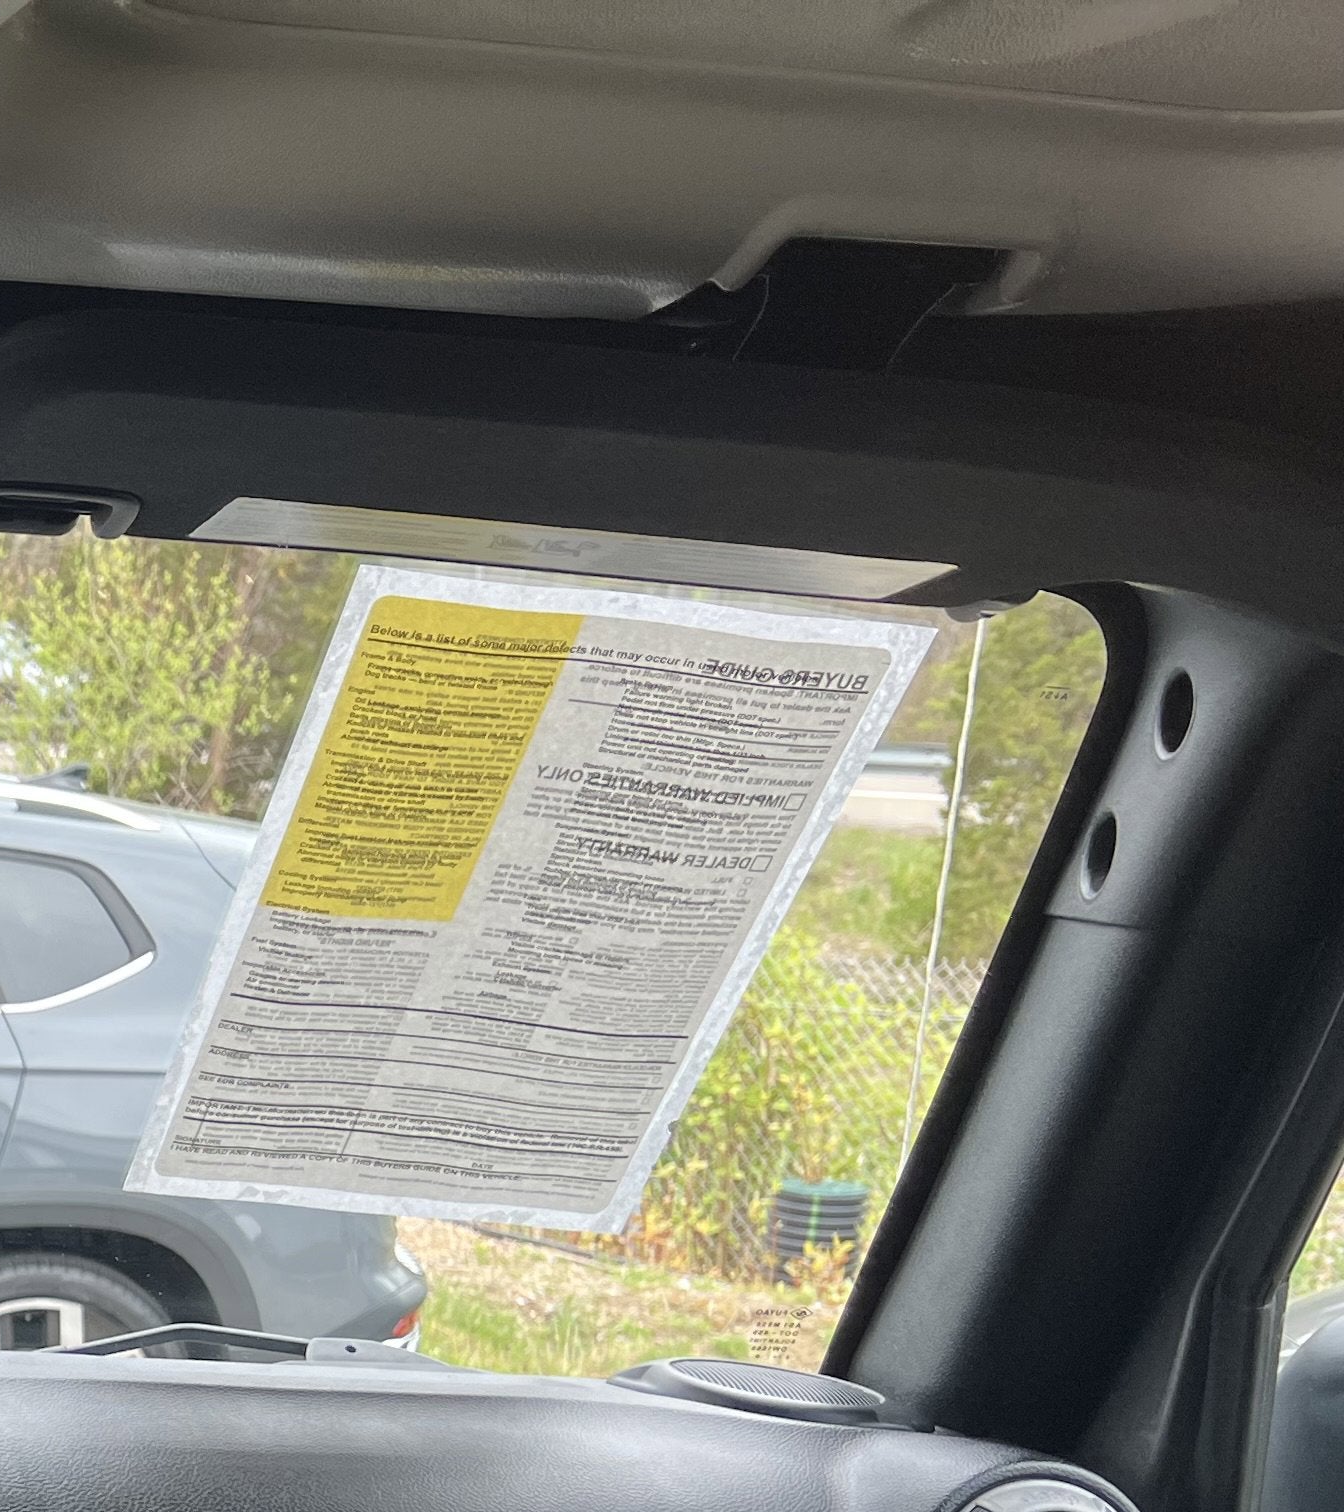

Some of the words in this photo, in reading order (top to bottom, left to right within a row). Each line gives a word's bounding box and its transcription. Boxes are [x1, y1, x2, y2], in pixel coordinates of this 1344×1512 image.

[370, 624, 412, 640] Below
[413, 630, 423, 641] is
[426, 634, 434, 642] a
[435, 633, 456, 646] list
[461, 636, 473, 647] of
[507, 641, 545, 654] major
[591, 647, 614, 658] that
[616, 650, 642, 664] may
[645, 655, 680, 668] occur
[683, 657, 694, 669] in
[217, 1023, 254, 1034] DEALER
